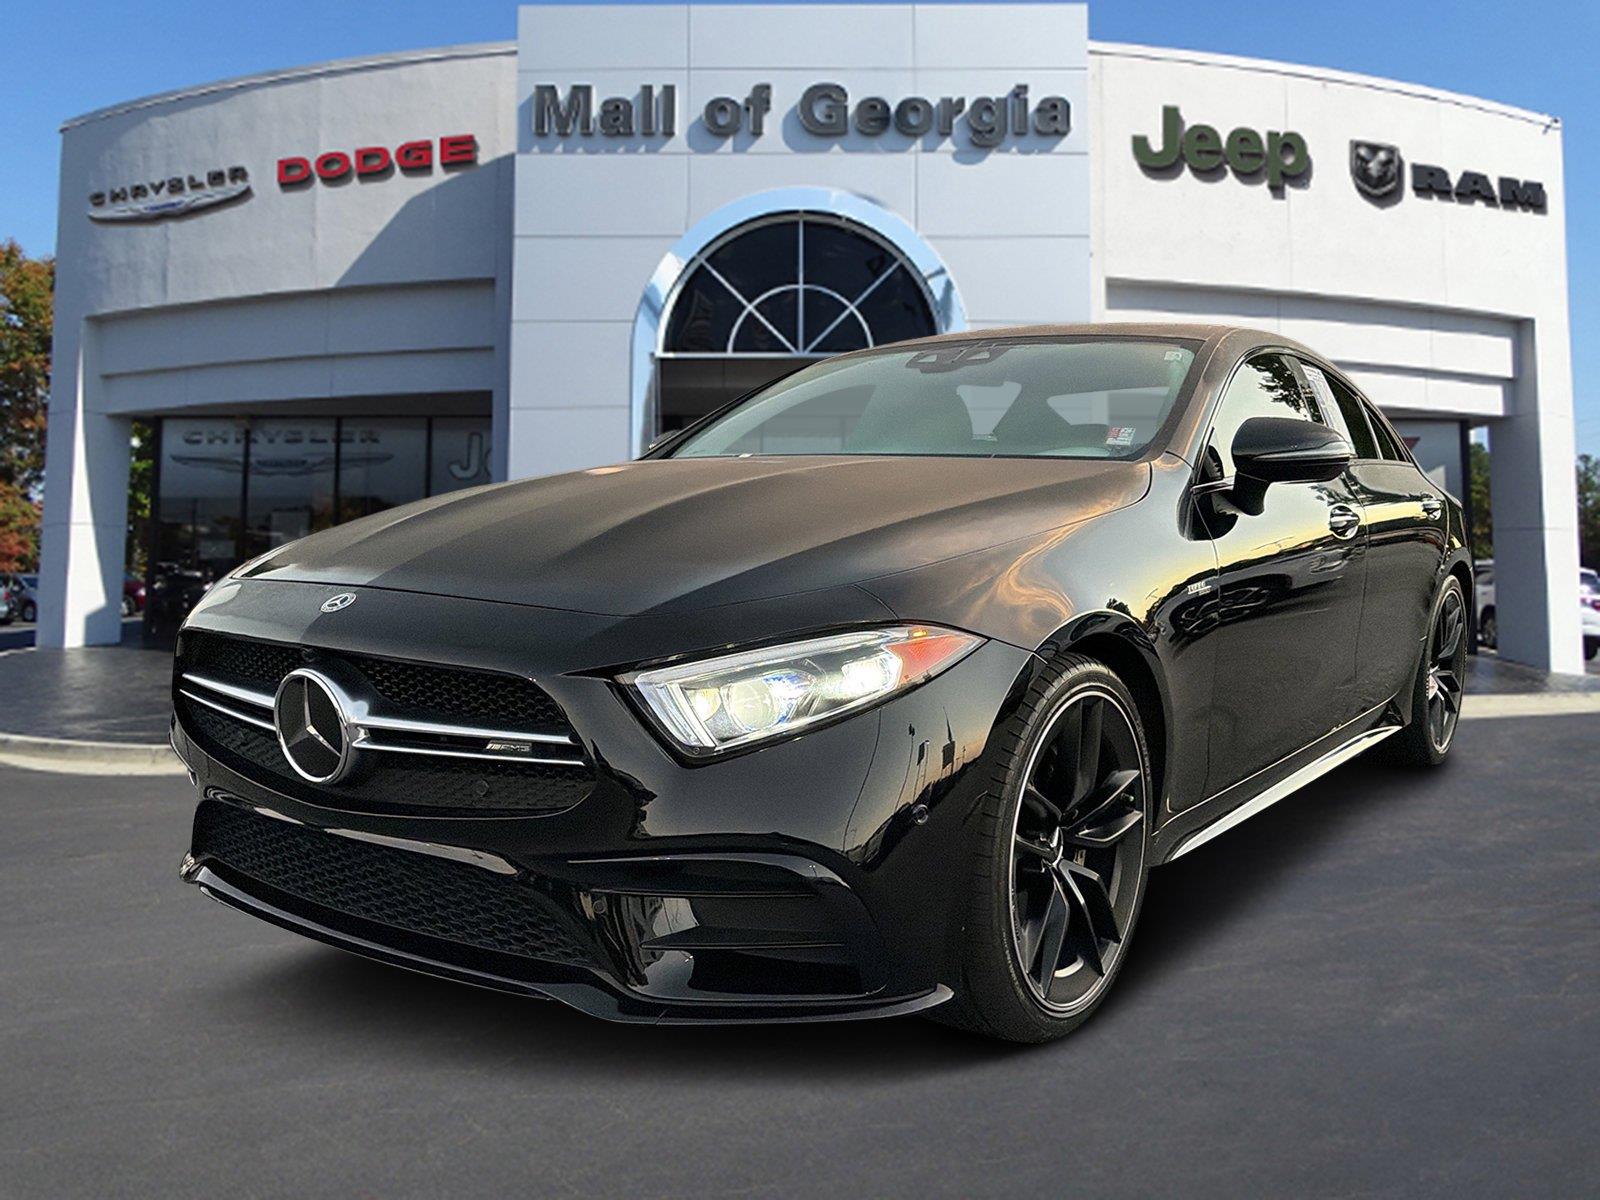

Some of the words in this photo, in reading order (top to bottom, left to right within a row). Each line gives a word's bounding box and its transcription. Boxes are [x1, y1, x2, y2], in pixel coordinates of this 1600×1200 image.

[533, 84, 676, 137] Mall
[703, 84, 772, 137] of
[800, 83, 1072, 147] Georgia
[277, 134, 476, 186] DODGE
[1132, 105, 1308, 189] Jeep
[89, 165, 249, 207] CHRYSLER
[1411, 163, 1546, 212] RAM
